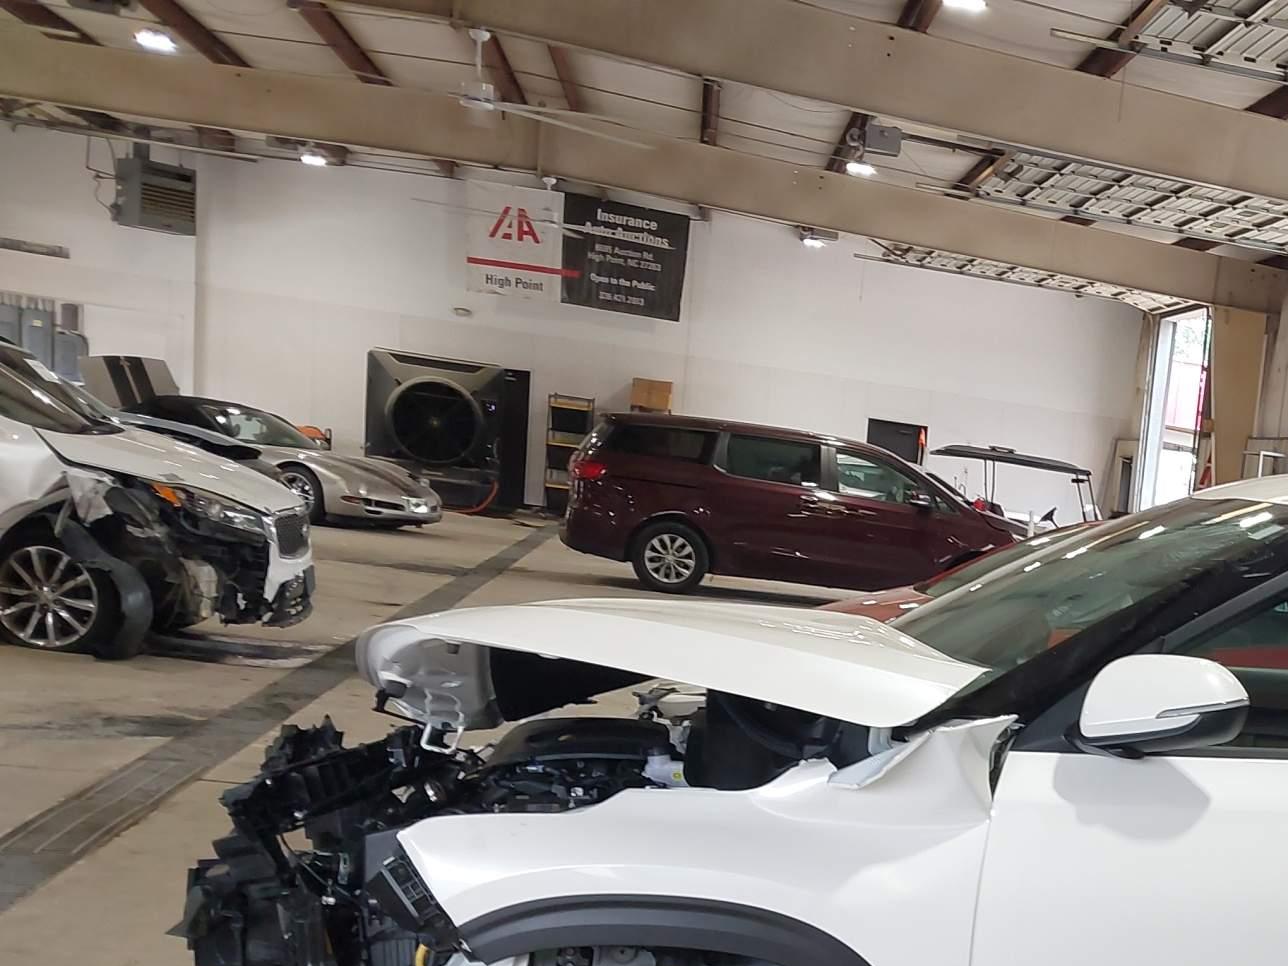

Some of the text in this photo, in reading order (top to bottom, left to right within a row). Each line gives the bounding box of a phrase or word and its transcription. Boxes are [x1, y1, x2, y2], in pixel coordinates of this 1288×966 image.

[596, 208, 658, 231] Insurance
[614, 226, 670, 247] Auctions
[485, 273, 543, 291] High Point
